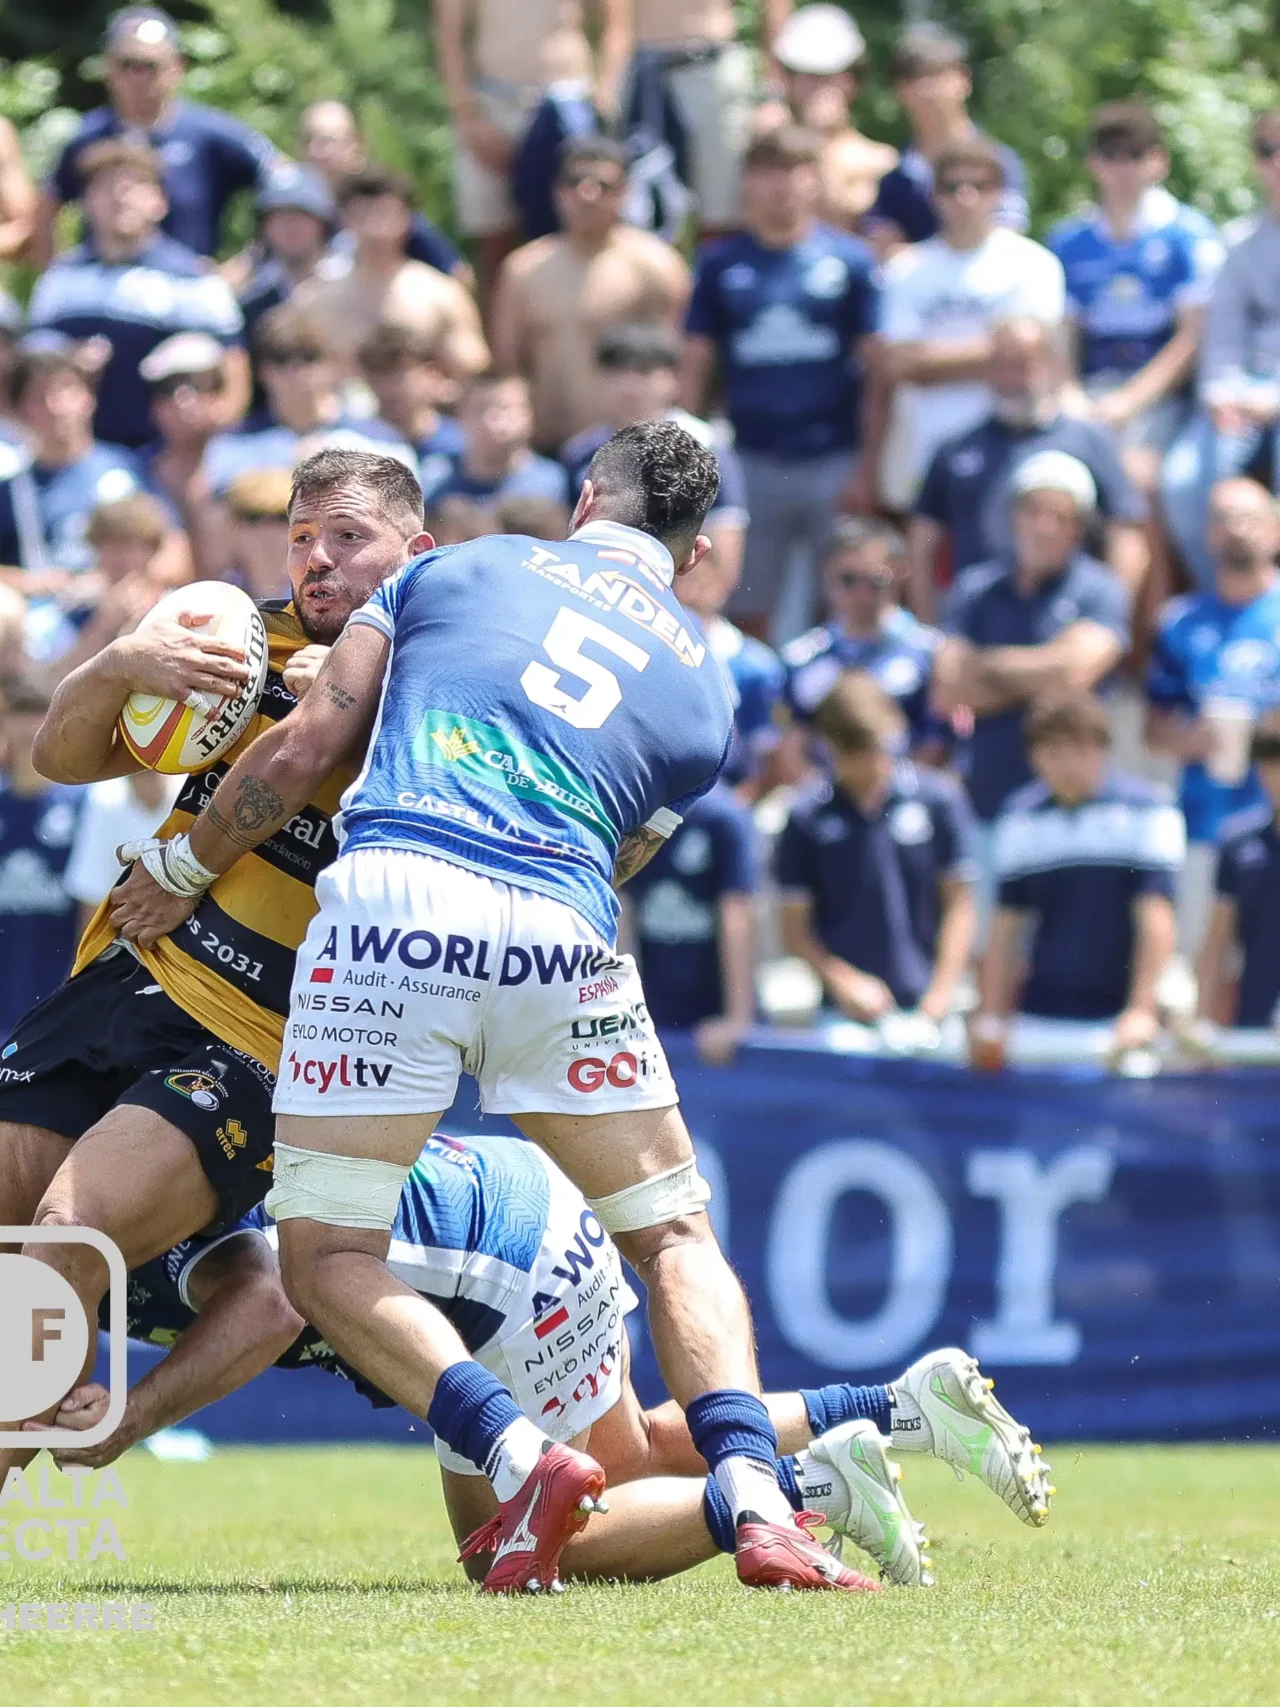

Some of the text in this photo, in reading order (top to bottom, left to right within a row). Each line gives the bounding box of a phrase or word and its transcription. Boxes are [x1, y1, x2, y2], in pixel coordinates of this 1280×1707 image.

[521, 559, 613, 612] TRANSPORTES
[529, 545, 707, 668] TANDEN
[520, 604, 651, 729] 5
[507, 773, 529, 788] DE
[397, 791, 521, 837] CASTILLA
[201, 932, 263, 981] 2031
[343, 968, 481, 1003] Audit Assurance
[297, 994, 404, 1019] NISSAN
[292, 1023, 398, 1048] EYLO MOTOR
[304, 1055, 394, 1094] cyltv
[577, 1269, 606, 1309] Audit
[525, 1277, 620, 1374] NISSAN
[534, 1357, 577, 1396] EYLO
